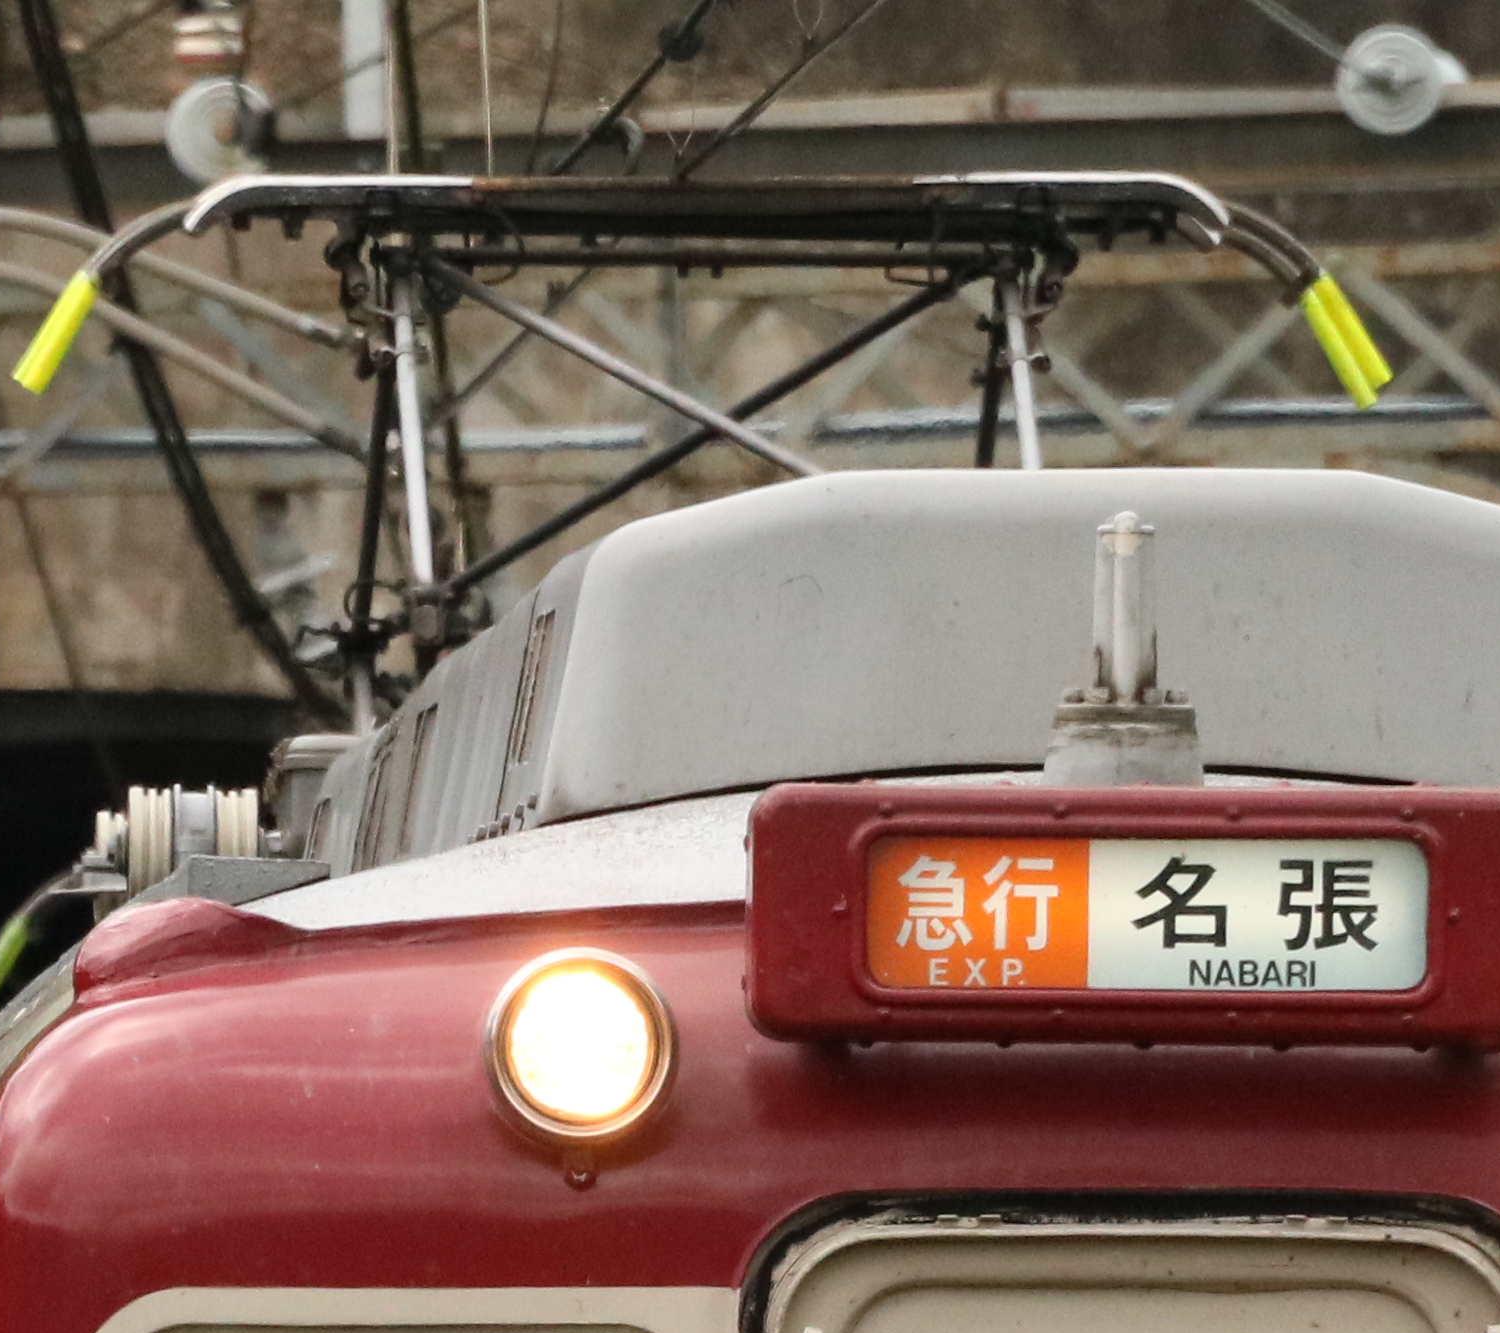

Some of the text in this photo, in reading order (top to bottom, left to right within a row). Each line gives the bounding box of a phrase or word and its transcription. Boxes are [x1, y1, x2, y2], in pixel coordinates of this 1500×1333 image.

[896, 855, 1059, 951] 急行
[1131, 855, 1379, 951] 名張
[1189, 959, 1316, 988] NABARI
